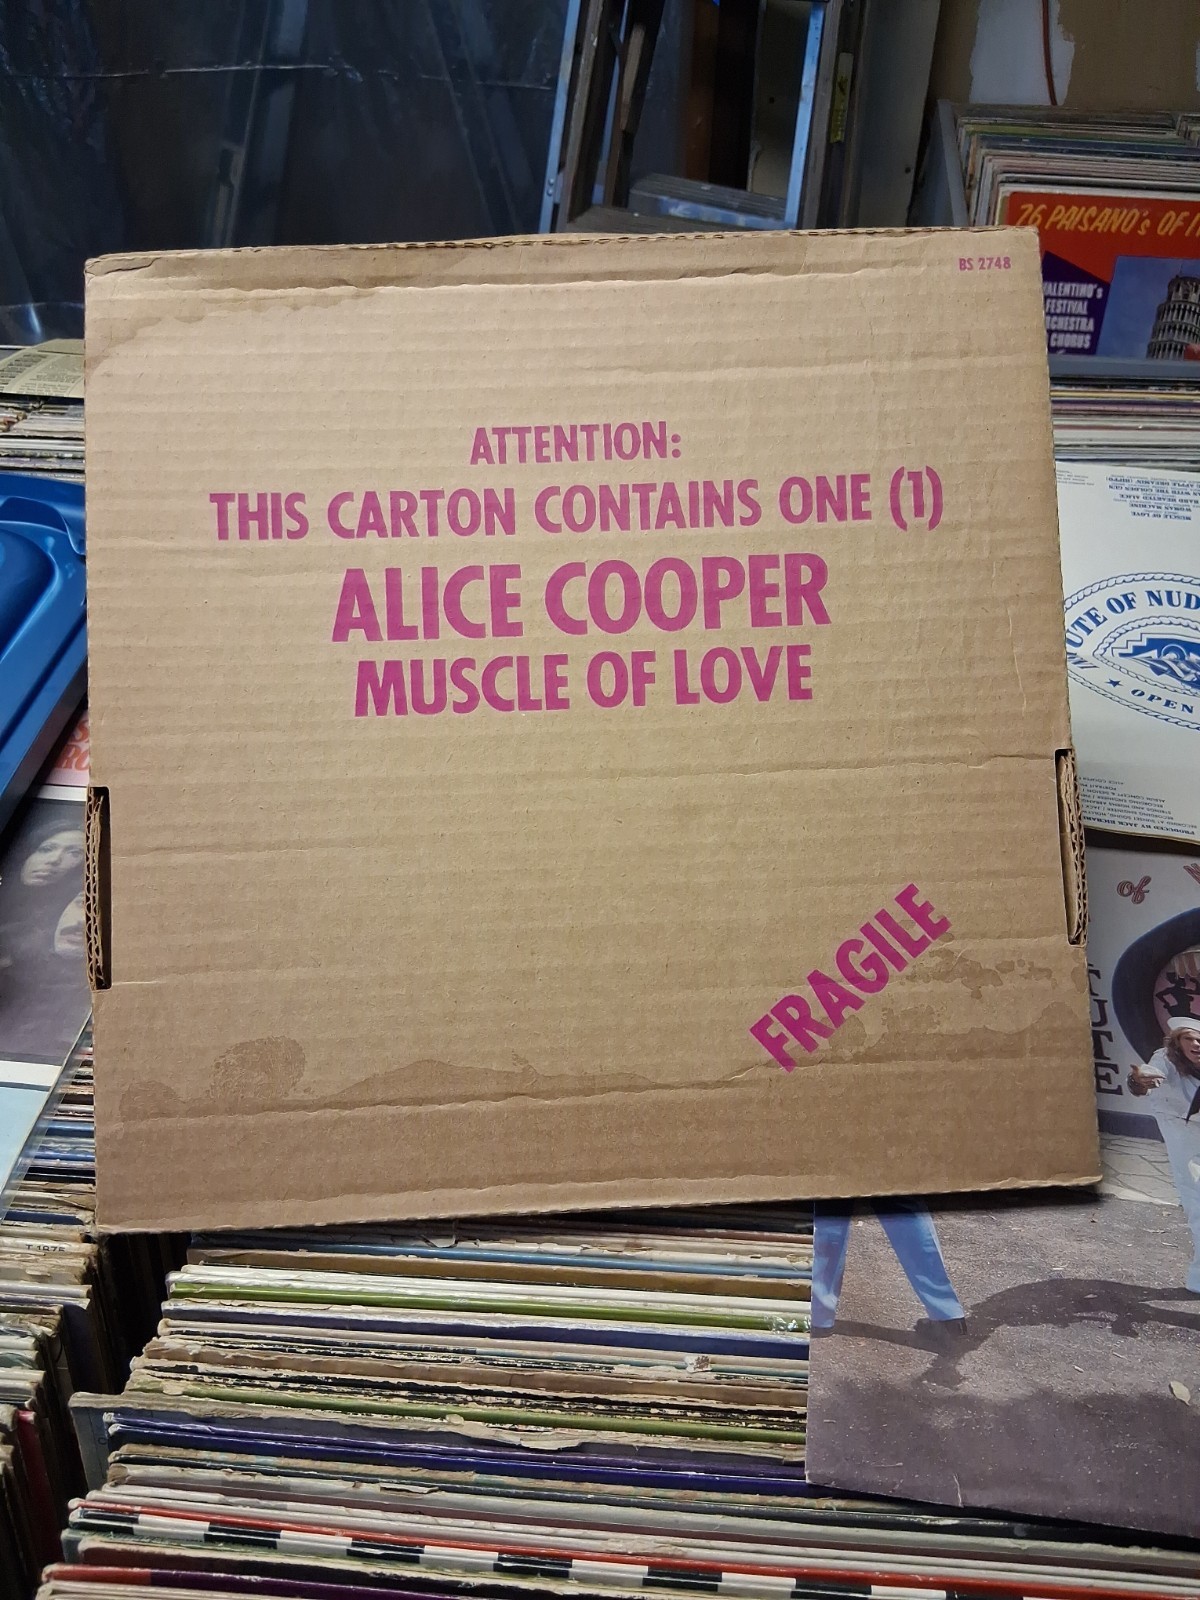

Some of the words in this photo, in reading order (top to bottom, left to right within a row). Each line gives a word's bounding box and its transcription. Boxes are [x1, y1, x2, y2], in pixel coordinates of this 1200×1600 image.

[1044, 204, 1150, 237] PAISANO's
[1156, 210, 1190, 237] OF
[959, 257, 974, 271] BS
[977, 256, 1012, 270] 2748
[1045, 299, 1089, 315] FESTIVAL
[1049, 332, 1092, 349] CHORUS
[469, 421, 681, 465] ATTENTION:
[208, 491, 309, 542] THIS
[326, 487, 516, 540] CARTON
[534, 479, 762, 534] CONTAINS
[778, 473, 871, 525] ONE
[890, 466, 943, 531] (1)
[332, 563, 523, 644] ALICE
[544, 552, 830, 636] COOPER
[1106, 592, 1137, 614] OF
[1145, 590, 1200, 610] NUD
[354, 653, 570, 718] MUSCLE
[587, 650, 656, 709] OF
[674, 643, 813, 705] LOVE
[1130, 688, 1194, 713] OPEN
[749, 884, 950, 1072] FRAGILE
